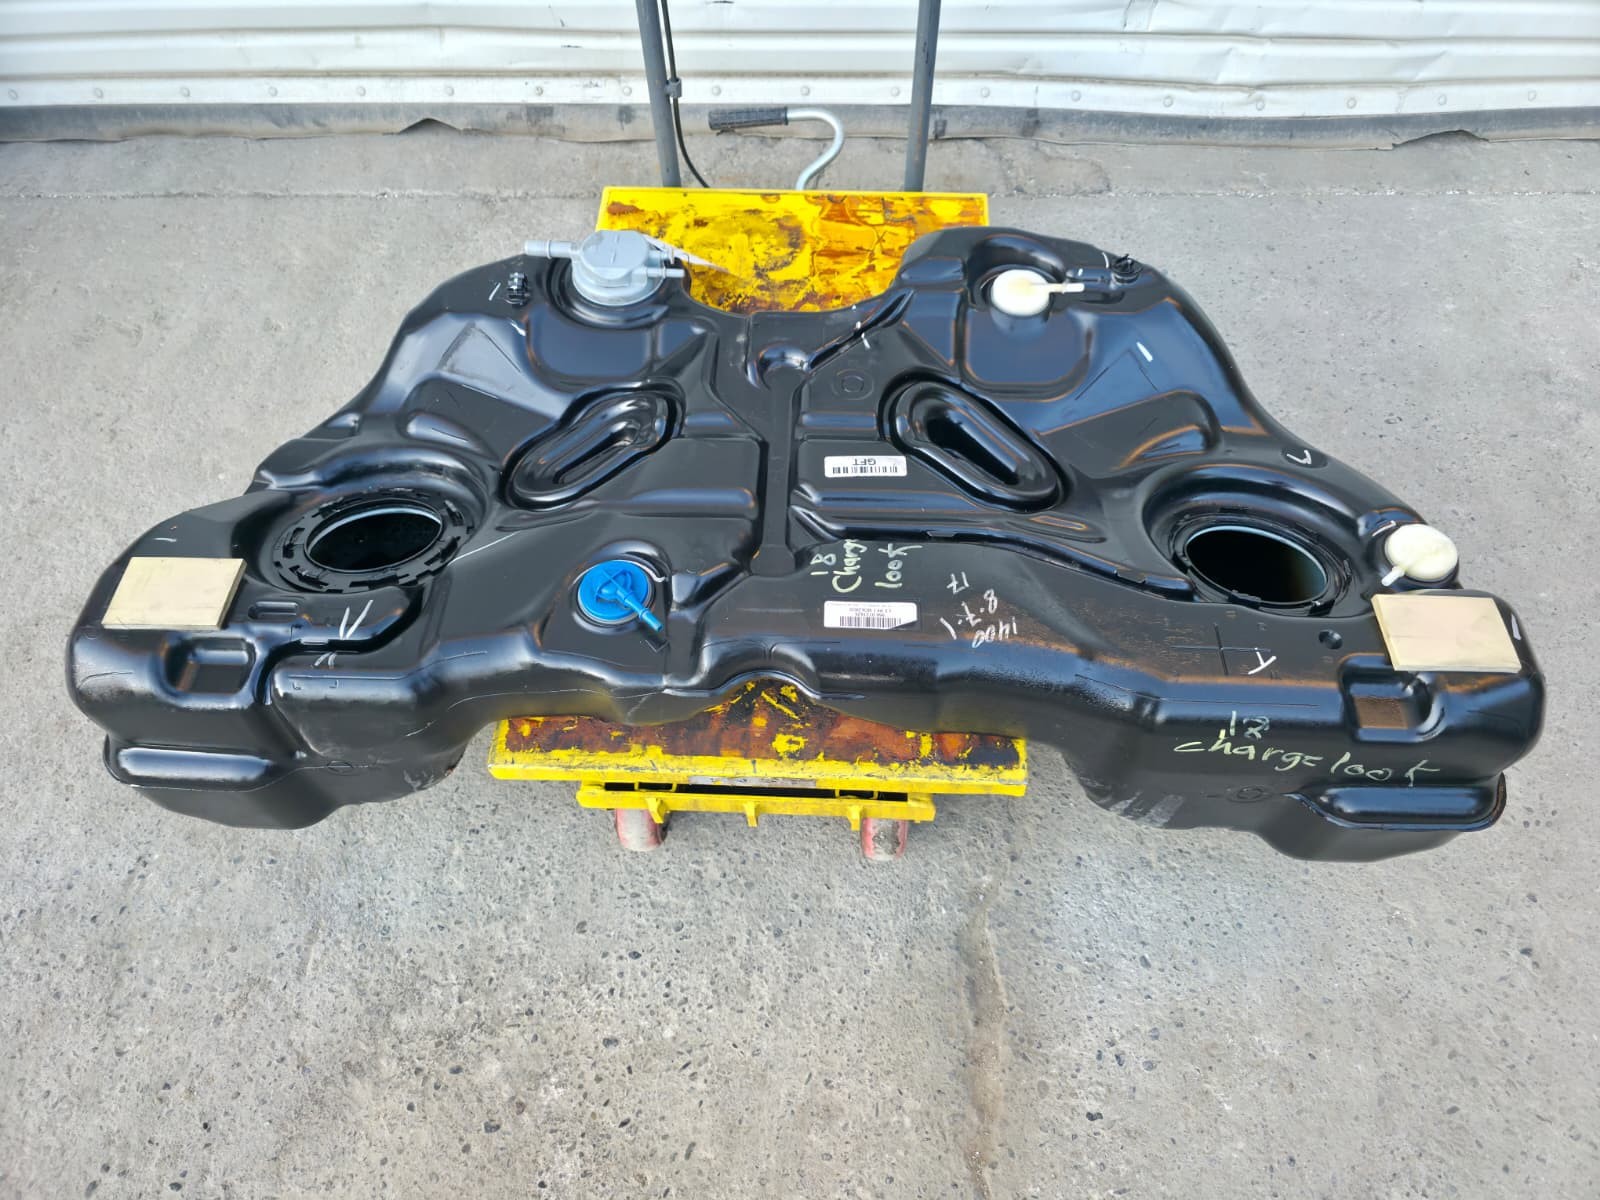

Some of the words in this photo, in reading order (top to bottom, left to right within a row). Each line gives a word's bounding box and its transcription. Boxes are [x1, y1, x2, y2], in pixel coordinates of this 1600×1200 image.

[852, 458, 877, 466] GFT
[810, 553, 836, 575] 18
[972, 616, 1018, 648] 1400
